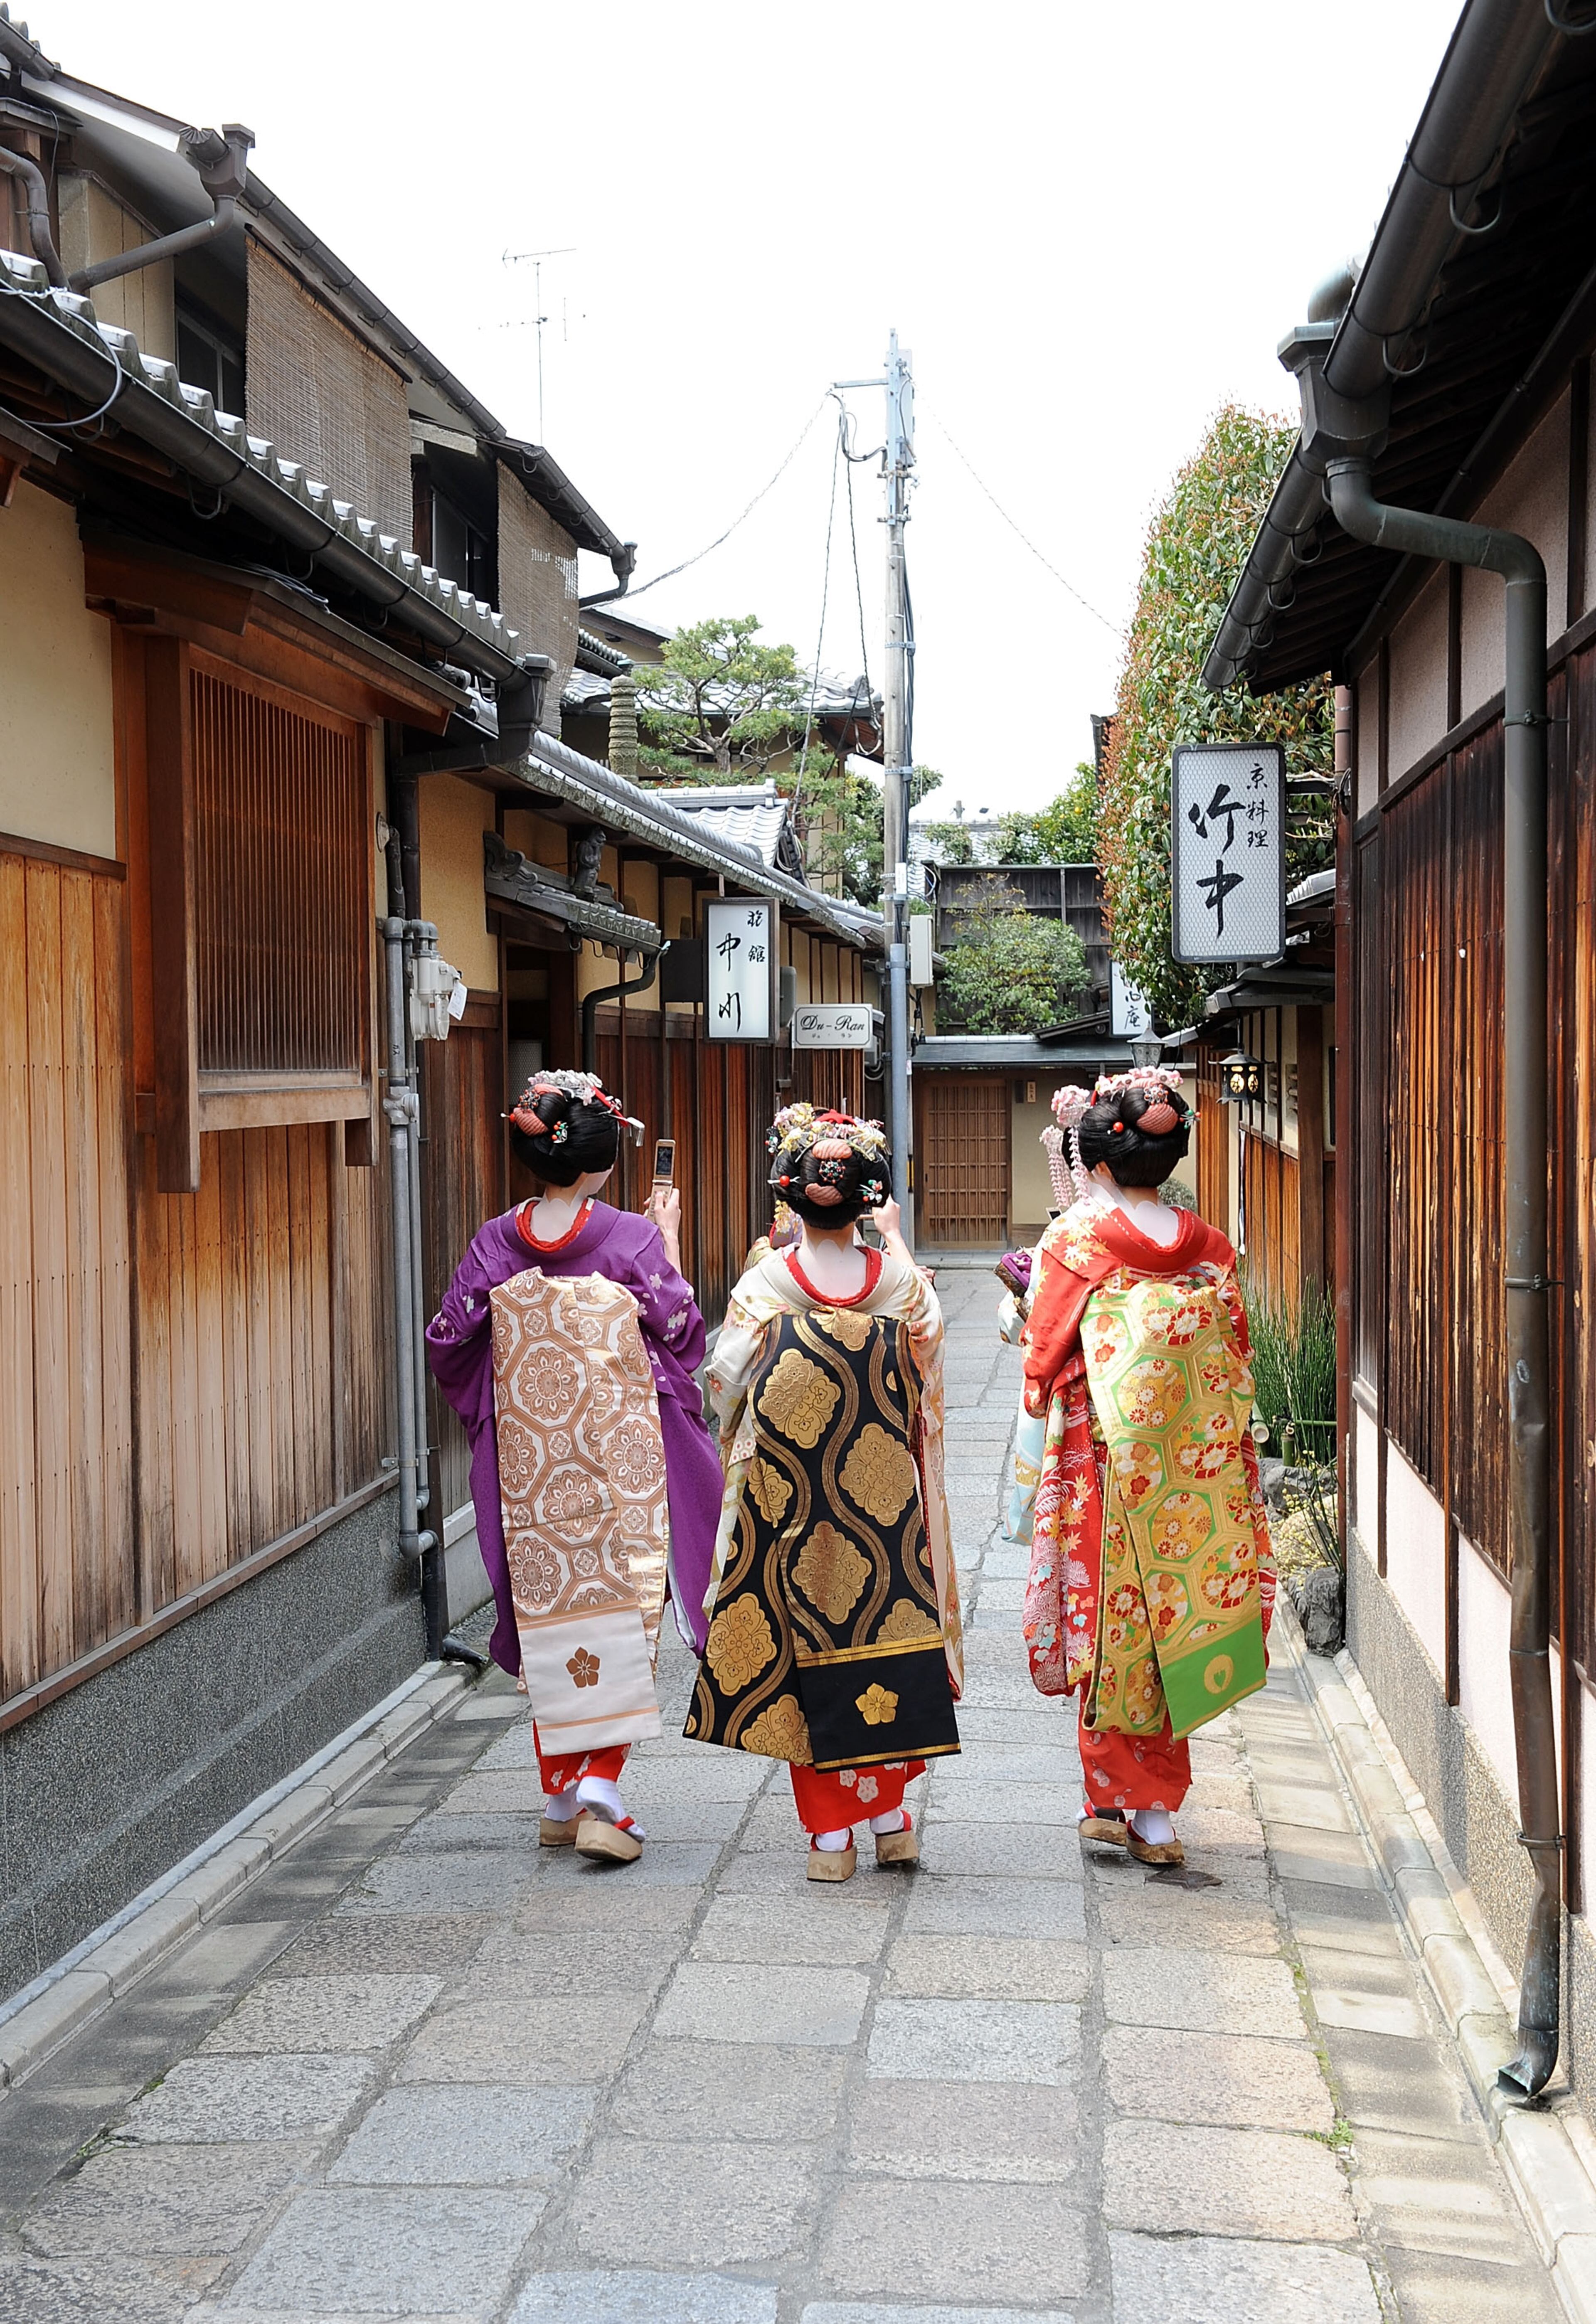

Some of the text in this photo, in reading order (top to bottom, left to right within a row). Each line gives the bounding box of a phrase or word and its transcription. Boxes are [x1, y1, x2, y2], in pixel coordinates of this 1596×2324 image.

[1246, 763, 1269, 848] 京料理
[1188, 784, 1246, 940] 竹中
[747, 910, 765, 962] 旅館
[716, 933, 741, 1032] 中川
